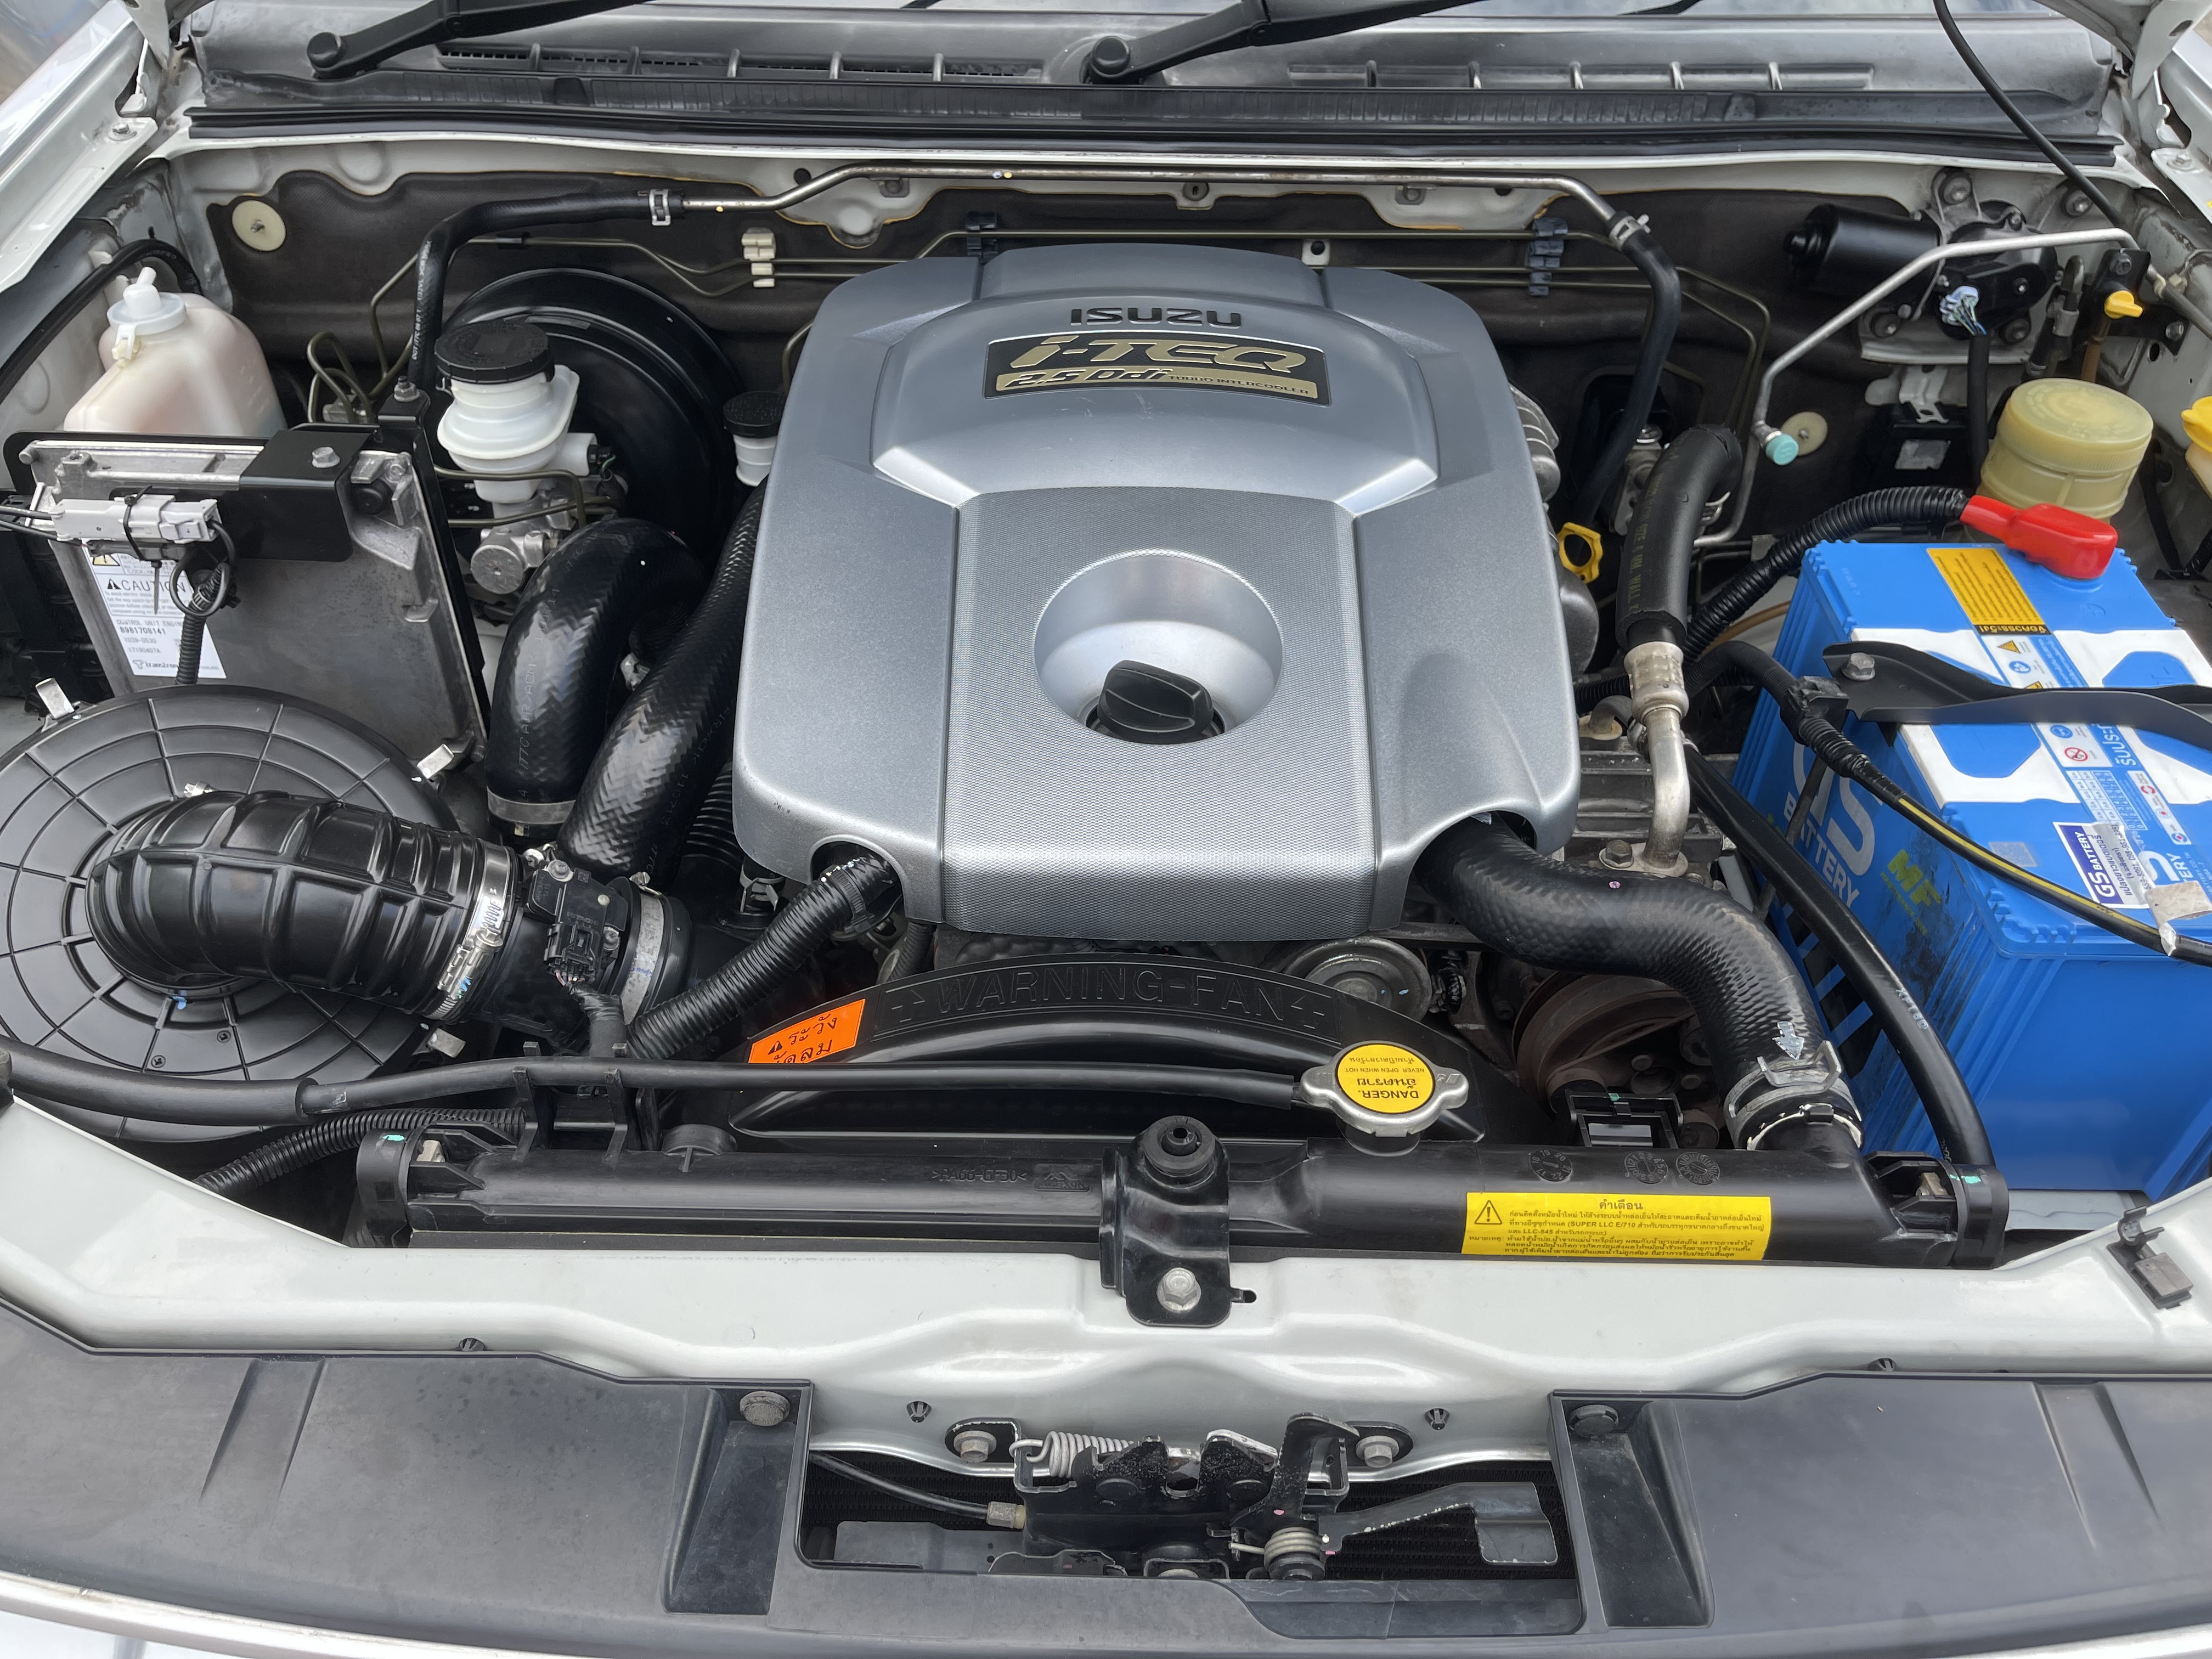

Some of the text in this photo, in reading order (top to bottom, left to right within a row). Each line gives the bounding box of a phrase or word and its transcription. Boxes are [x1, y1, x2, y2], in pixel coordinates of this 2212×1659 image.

[1071, 307, 1242, 328] ISUZU
[1169, 375, 1214, 383] TURBO
[1217, 377, 1309, 394] INTERCOOLER
[2074, 831, 2102, 871] BATTERY
[1887, 848, 1943, 905] MF
[2087, 871, 2117, 899] GS
[774, 1037, 833, 1063] ัดลม
[1357, 1077, 1417, 1089] อันตราย
[1358, 1090, 1419, 1099] DANGER.
[1554, 1153, 1566, 1161] 20
[1599, 1198, 1643, 1211] คำเตือน
